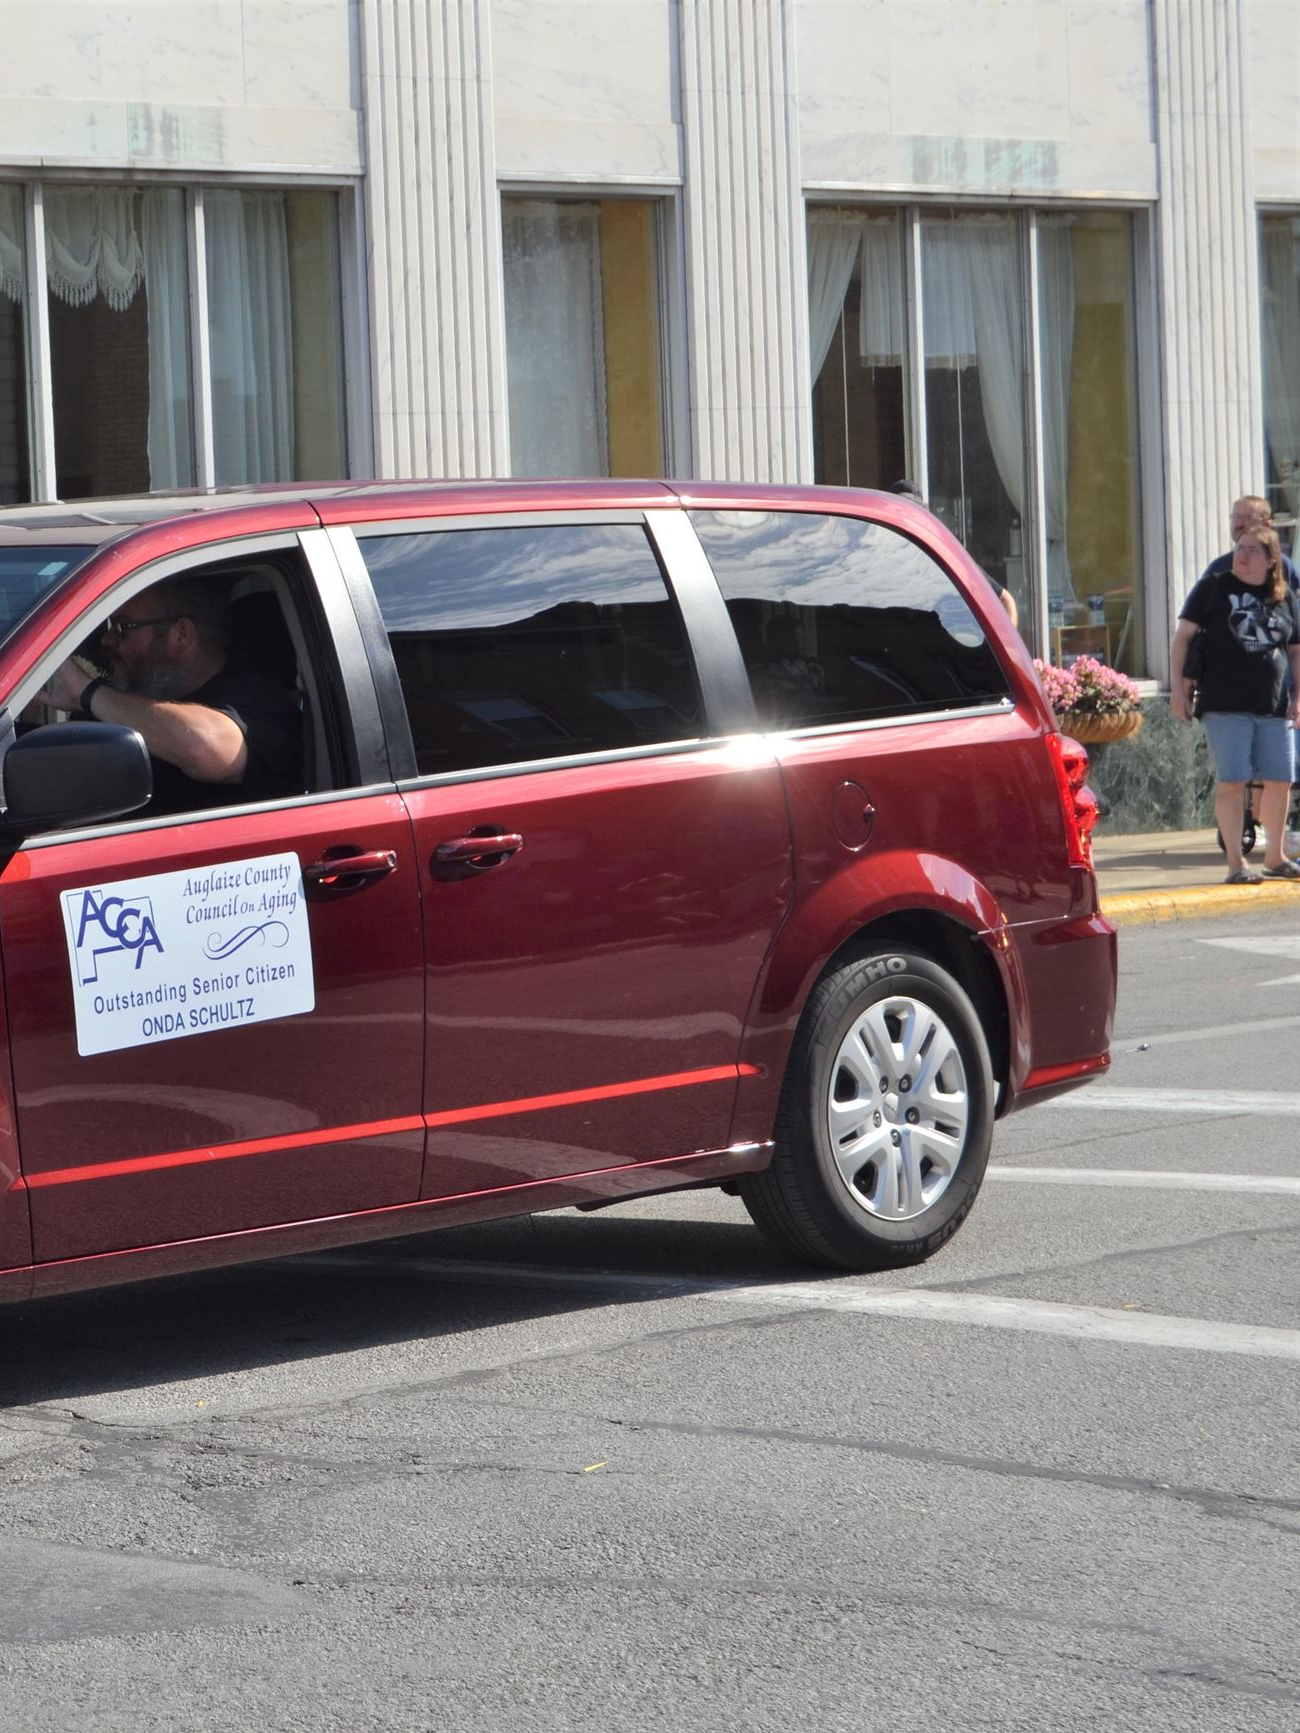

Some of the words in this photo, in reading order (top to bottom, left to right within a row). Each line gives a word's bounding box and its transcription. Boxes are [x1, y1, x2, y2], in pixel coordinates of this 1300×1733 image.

[183, 870, 241, 901] Auglaize
[245, 863, 291, 888] County
[186, 895, 240, 924] Council
[258, 891, 297, 918] Aging
[94, 983, 187, 1014] Outstanding
[193, 973, 240, 995] Senior
[245, 962, 295, 985] Citizen
[142, 1012, 186, 1037] ONDA
[190, 998, 255, 1027] SCHULTZ
